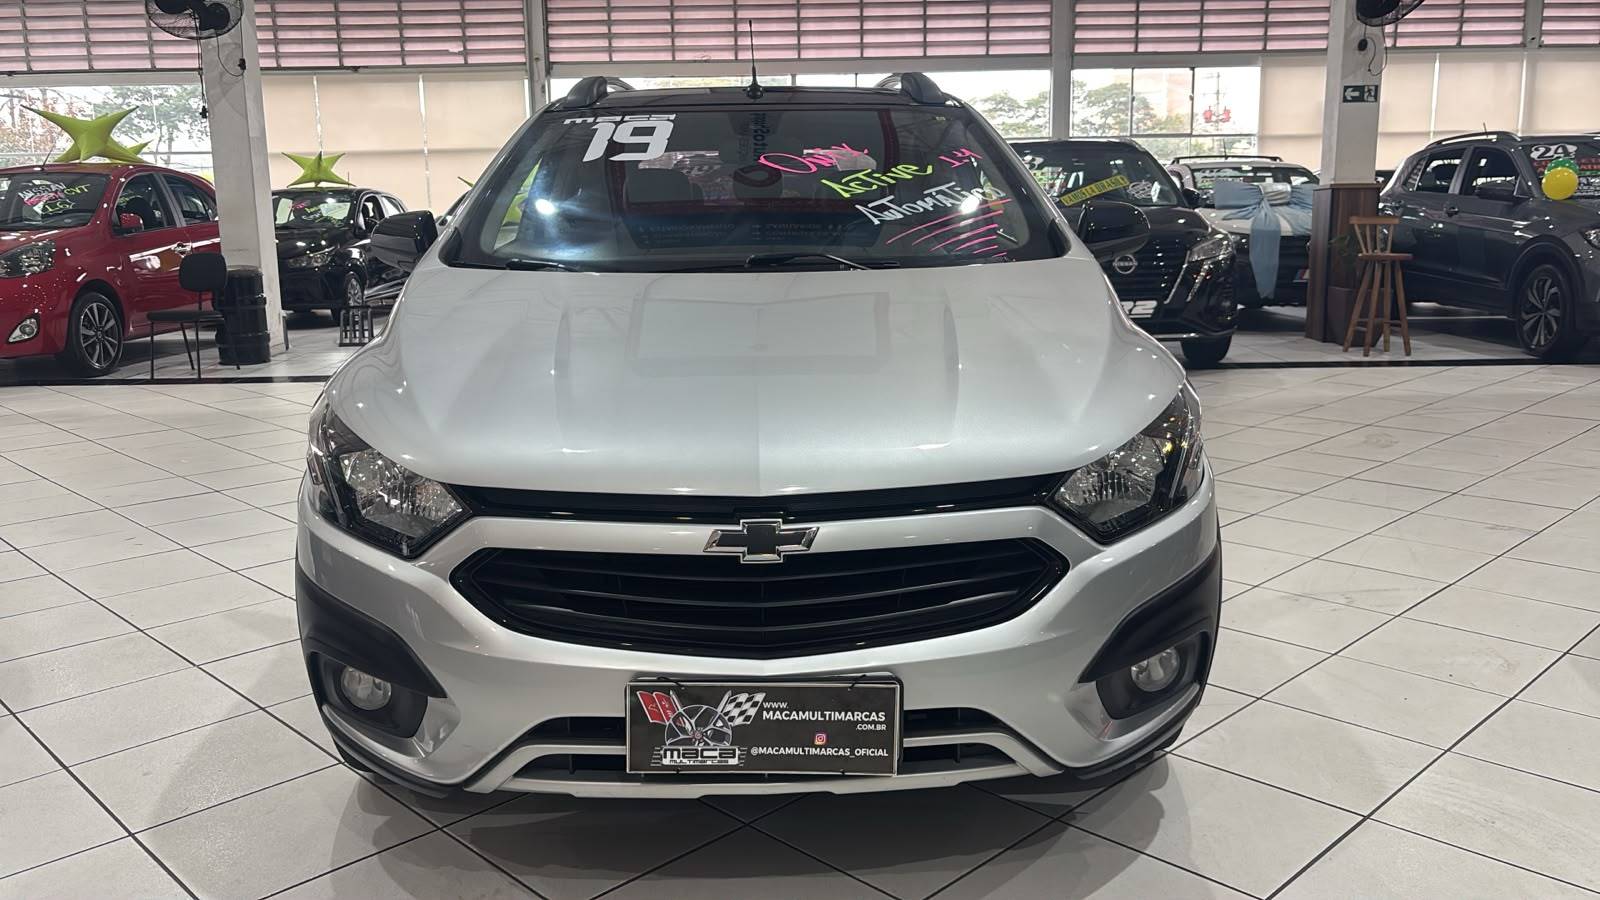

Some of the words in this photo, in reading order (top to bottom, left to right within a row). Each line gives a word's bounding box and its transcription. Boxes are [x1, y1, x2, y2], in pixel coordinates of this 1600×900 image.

[563, 113, 677, 125] maca
[582, 119, 674, 162] 19
[762, 710, 886, 722] MACAMULTIMARCAS
[855, 723, 887, 731] .COM.BR
[663, 748, 737, 759] maca
[750, 746, 889, 759] @MACAMULTIMARCAS_OFICIAL
